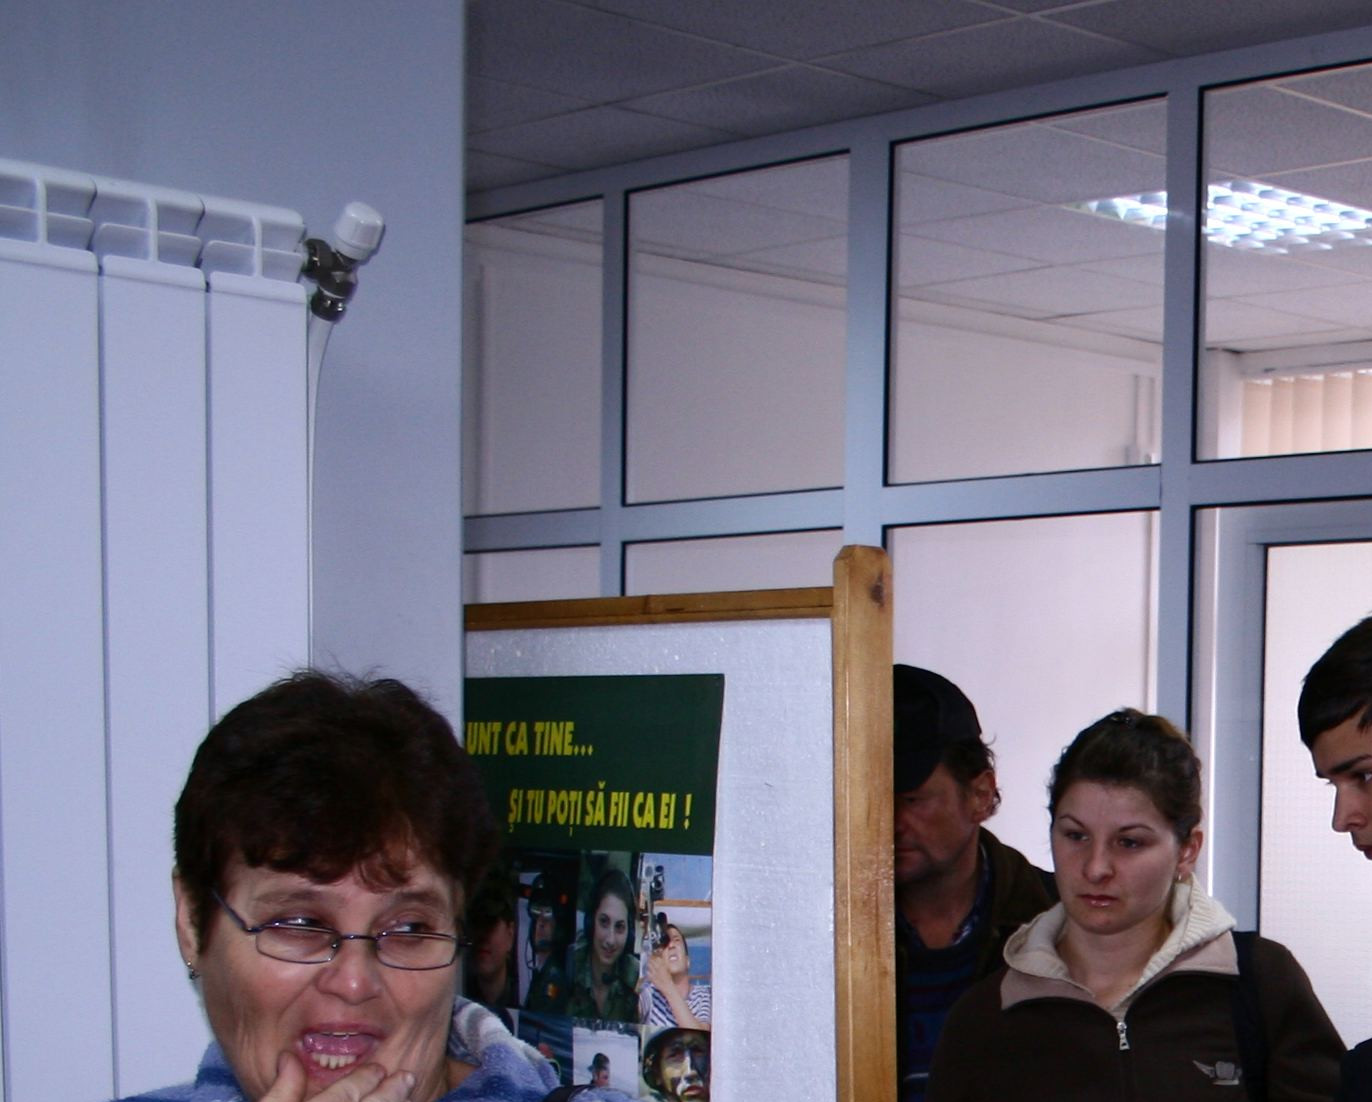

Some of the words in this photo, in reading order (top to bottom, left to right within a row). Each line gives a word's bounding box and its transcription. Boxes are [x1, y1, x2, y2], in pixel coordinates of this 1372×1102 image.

[466, 721, 502, 755] UNT
[505, 721, 528, 756] CA
[534, 721, 593, 756] TINE...
[526, 789, 544, 825] TU
[547, 790, 582, 837] POȚI
[585, 780, 606, 827] SĂ
[609, 791, 630, 827] FII
[633, 791, 655, 829] CA
[659, 793, 676, 829] EI
